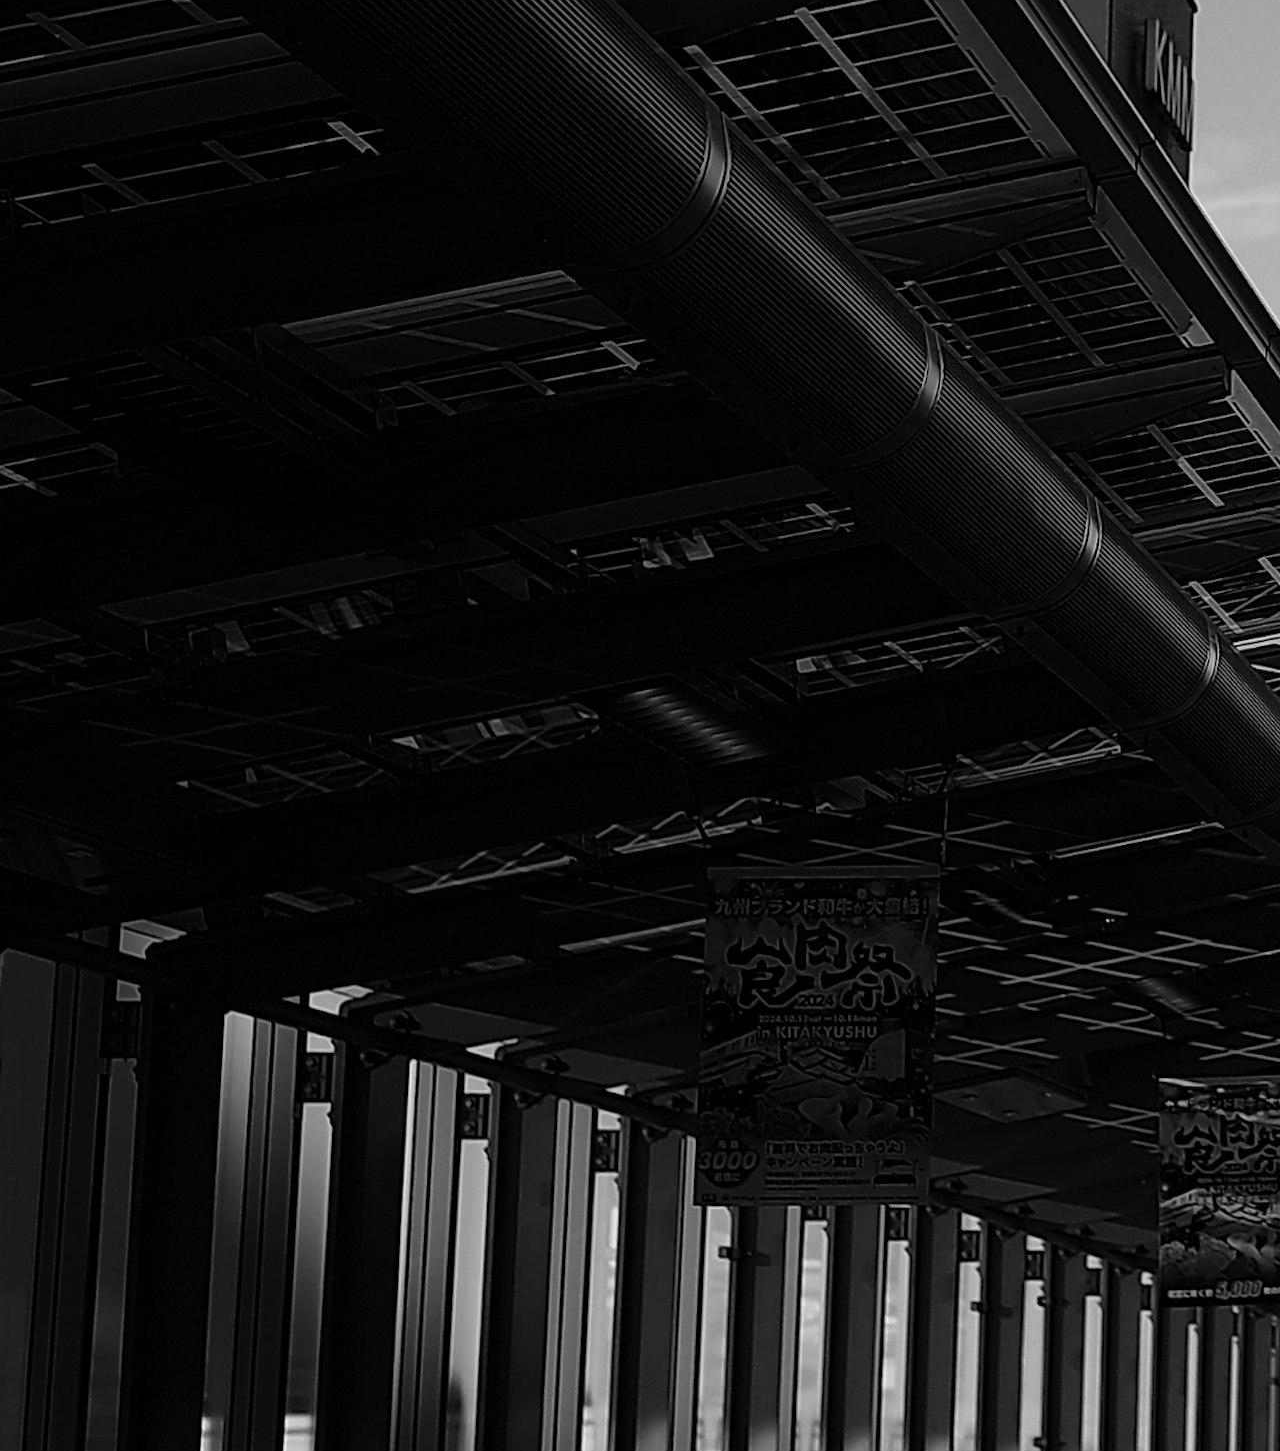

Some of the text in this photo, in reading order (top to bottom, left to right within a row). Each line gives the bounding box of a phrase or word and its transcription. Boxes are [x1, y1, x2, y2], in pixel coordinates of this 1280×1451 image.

[798, 994, 834, 1007] 2024
[756, 1026, 877, 1038] in KITAKYUSHU
[698, 1151, 757, 1170] 3000
